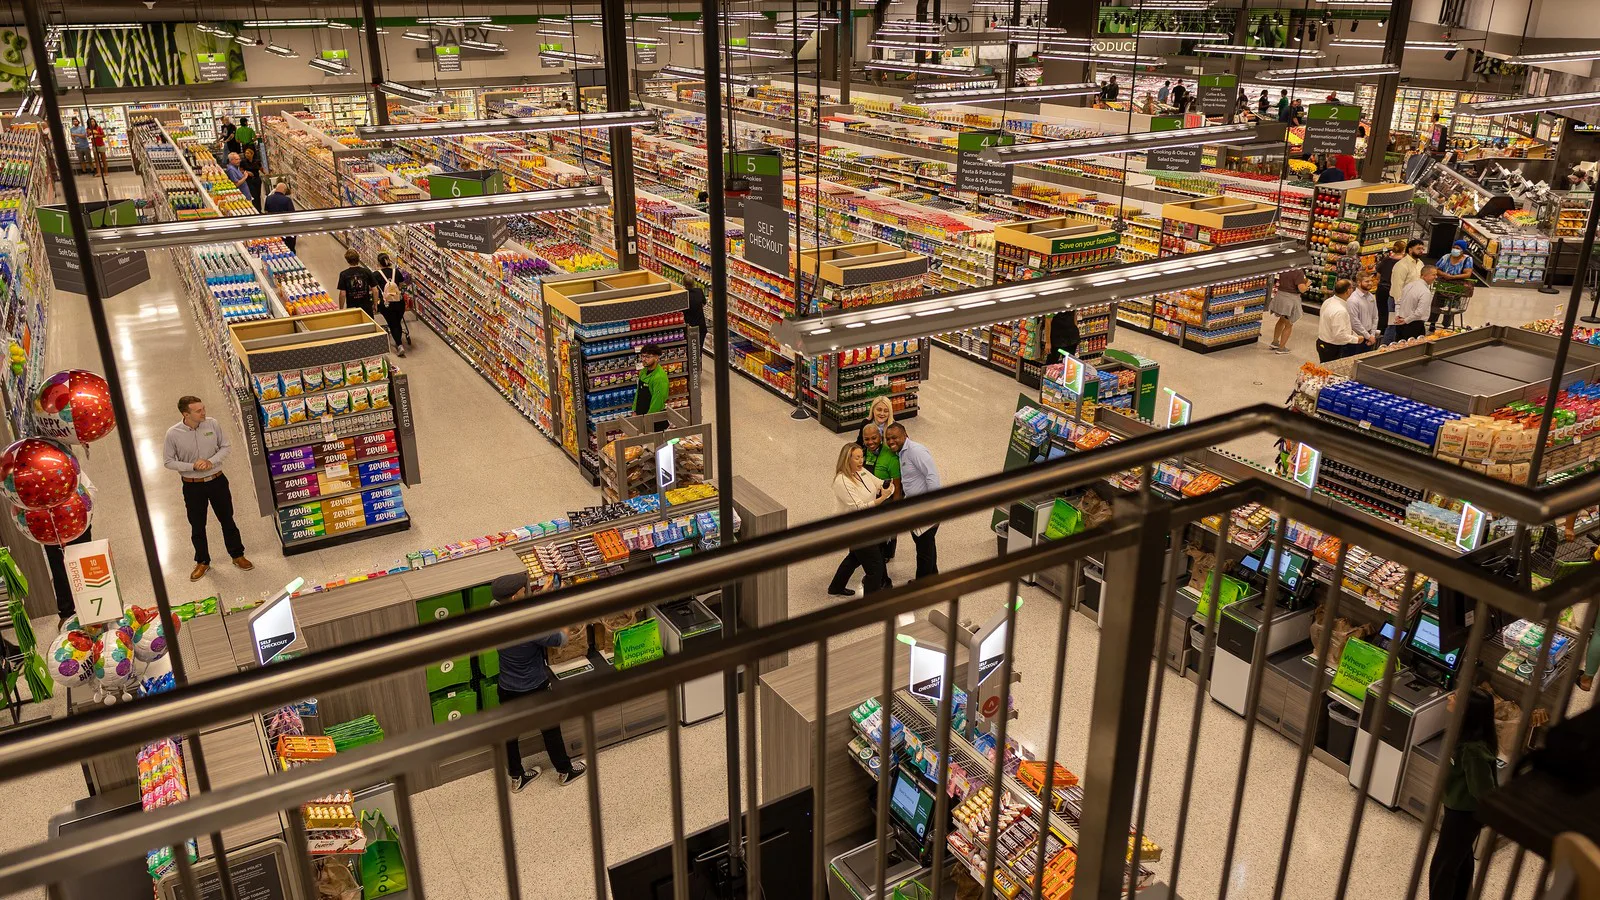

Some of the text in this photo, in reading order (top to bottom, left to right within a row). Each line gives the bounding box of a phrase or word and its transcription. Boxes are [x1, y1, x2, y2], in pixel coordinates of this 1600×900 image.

[426, 28, 489, 48] DAIRY
[1090, 41, 1137, 52] RODUCE
[1214, 77, 1220, 86] 1
[1328, 107, 1339, 119] 2
[1174, 120, 1182, 129] 3
[980, 136, 991, 149] 4
[747, 157, 756, 173] 5
[452, 181, 461, 197] 6
[55, 213, 64, 233] 7
[757, 221, 774, 236] SELF
[55, 236, 70, 246] Bottled
[438, 229, 455, 237] Peanut
[474, 235, 485, 243] Jelly
[446, 240, 462, 248] Sports
[749, 232, 784, 255] CHECKOUT
[1082, 240, 1096, 249] your
[1096, 235, 1117, 244] favorites
[58, 248, 79, 258] Soft Drin
[65, 261, 80, 270] Water
[117, 256, 130, 265] Water
[399, 387, 411, 427] GUARANTEED
[246, 414, 260, 456] GUARANTEED
[279, 449, 304, 460] zevia
[282, 461, 306, 472] zevia
[284, 476, 308, 488] zevia
[286, 489, 310, 500] zevia
[288, 505, 312, 517] zevia
[290, 517, 314, 528] zevia
[292, 529, 316, 539] zevia
[89, 558, 98, 567] 10
[69, 561, 84, 592] EXPRESS
[89, 597, 103, 616] 7
[260, 639, 288, 650] CHECKOUT
[624, 642, 646, 653] Where
[624, 648, 655, 660] shopping
[1344, 653, 1366, 669] Where
[1341, 661, 1374, 682] shopping
[930, 676, 941, 684] SELF
[1343, 671, 1369, 686] pleasur
[918, 681, 940, 692] CHECKOUT
[246, 863, 263, 872] POLICY
[250, 888, 271, 899] TOBACCO
